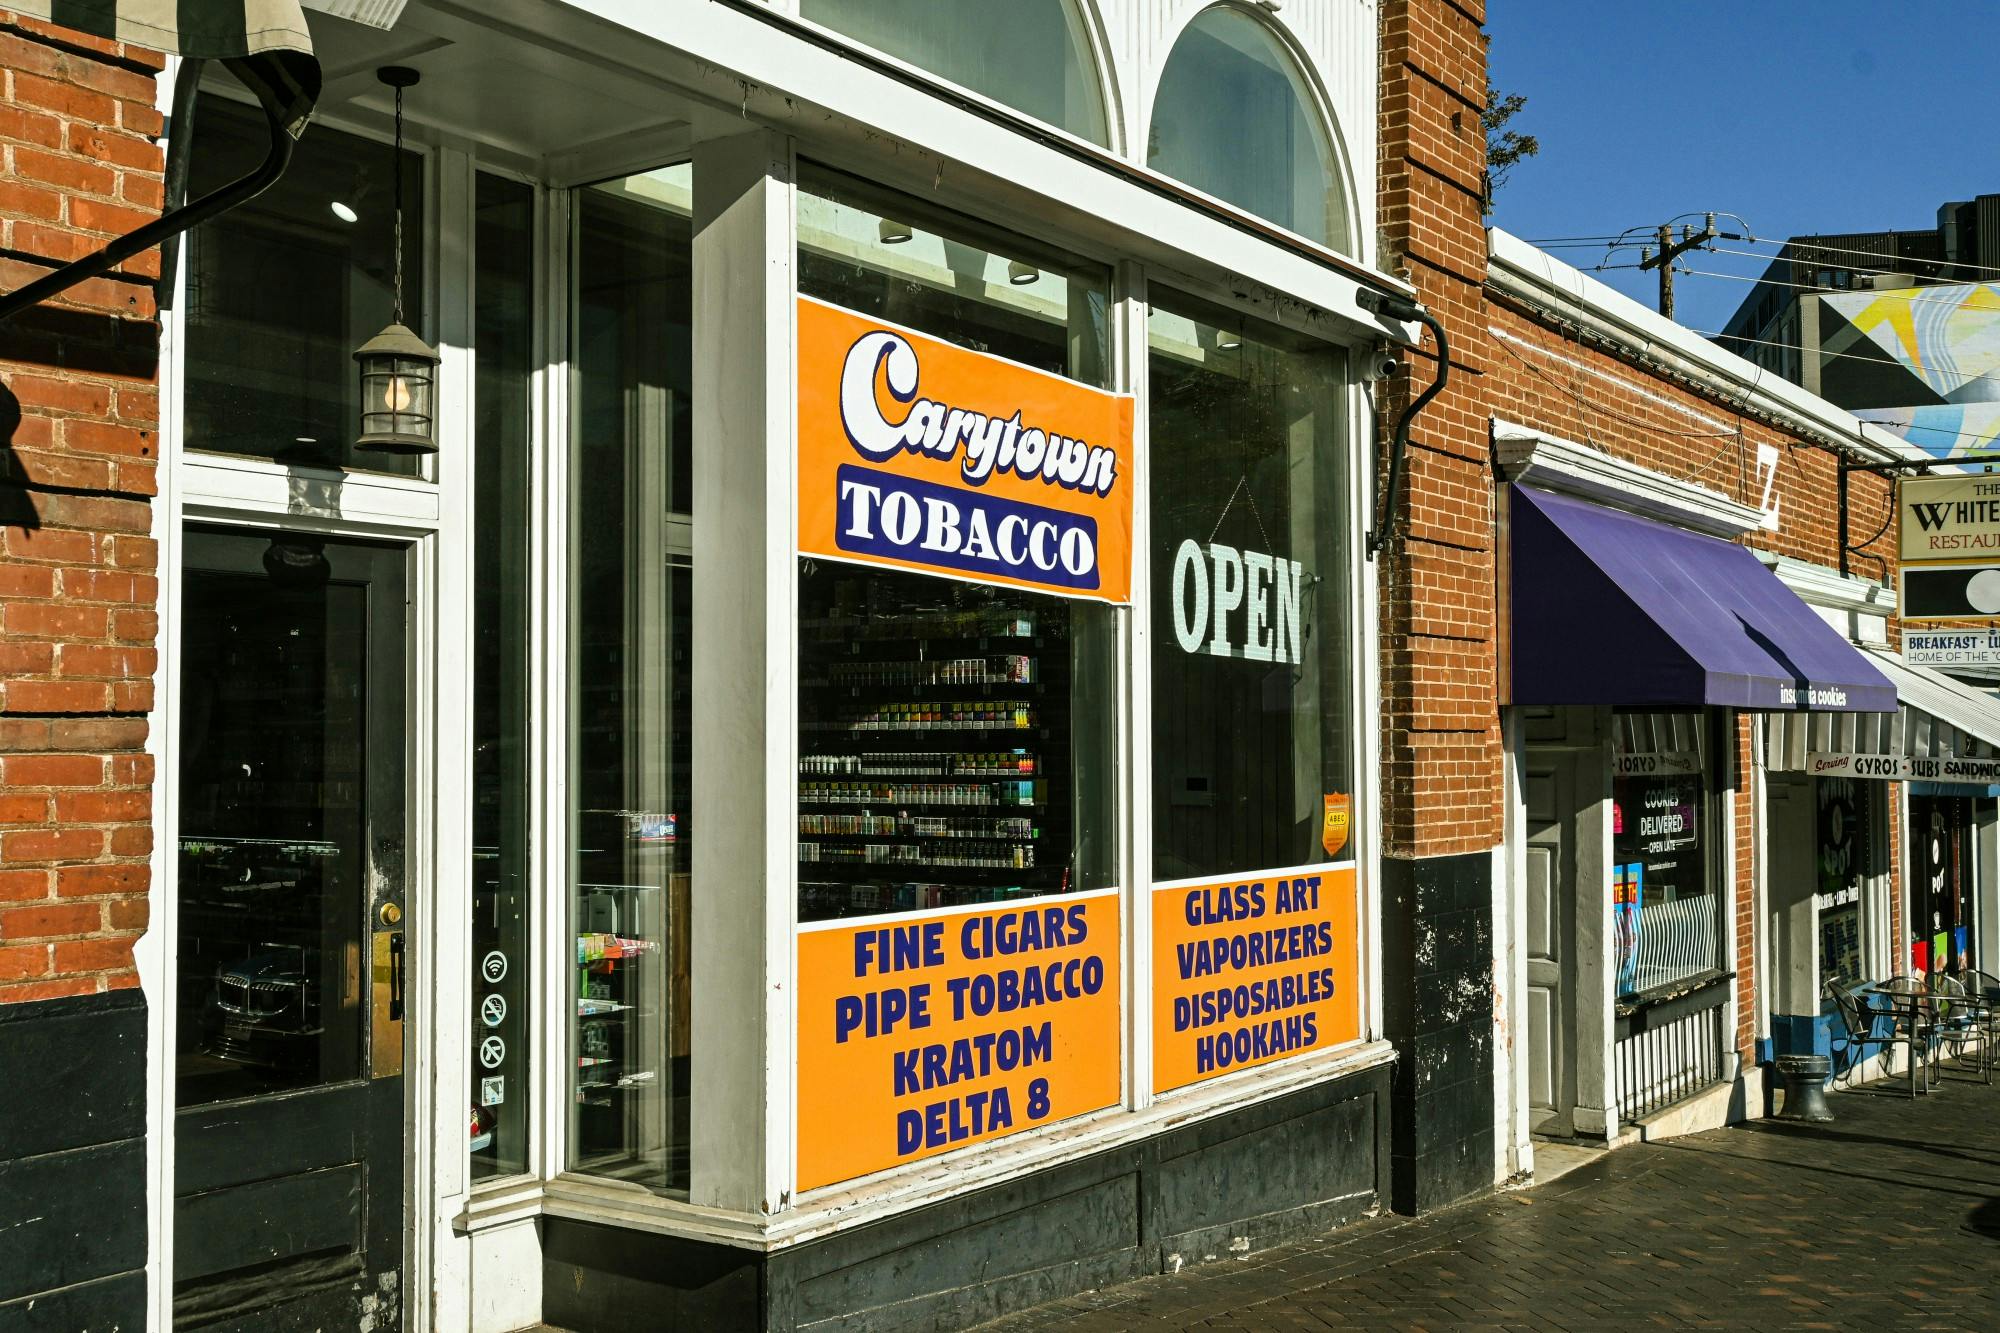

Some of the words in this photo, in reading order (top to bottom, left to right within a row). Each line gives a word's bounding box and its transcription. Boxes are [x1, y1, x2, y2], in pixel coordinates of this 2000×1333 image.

[840, 330, 1118, 498] Carytown
[1910, 501, 1999, 531] WHITE
[1973, 484, 2000, 496] THE
[842, 481, 1095, 575] TOBACCO
[1173, 539, 1301, 664] OPEN
[1909, 637, 1978, 649] BREAKFAST
[1909, 652, 1942, 661] HOME
[1946, 652, 1961, 661] OF
[1965, 652, 1988, 661] THE
[1781, 683, 1816, 704] insomnia
[1818, 686, 1846, 706] cookies
[1814, 756, 1849, 772] Serving
[1855, 758, 1898, 775] GYROS
[1911, 760, 1939, 777] SUBS
[1645, 788, 1679, 808] COOKIES
[1641, 814, 1683, 836] DELIVERED
[1649, 841, 1663, 853] OPEN
[1664, 840, 1676, 852] LATE
[1186, 883, 1265, 926] GLASS
[1276, 877, 1321, 914] ART
[855, 922, 944, 977] FINE
[961, 905, 1087, 960] CIGARS
[1176, 922, 1332, 980] VAPORIZERS
[836, 984, 930, 1043] PIPE
[947, 956, 1104, 1021] TOBACCO
[1174, 968, 1334, 1032] DISPOSABLES
[894, 1022, 1051, 1097] KRATOM
[1197, 1012, 1317, 1074] HOOKAHS
[897, 1087, 1012, 1156] DELTA
[1027, 1078, 1050, 1120] 8
